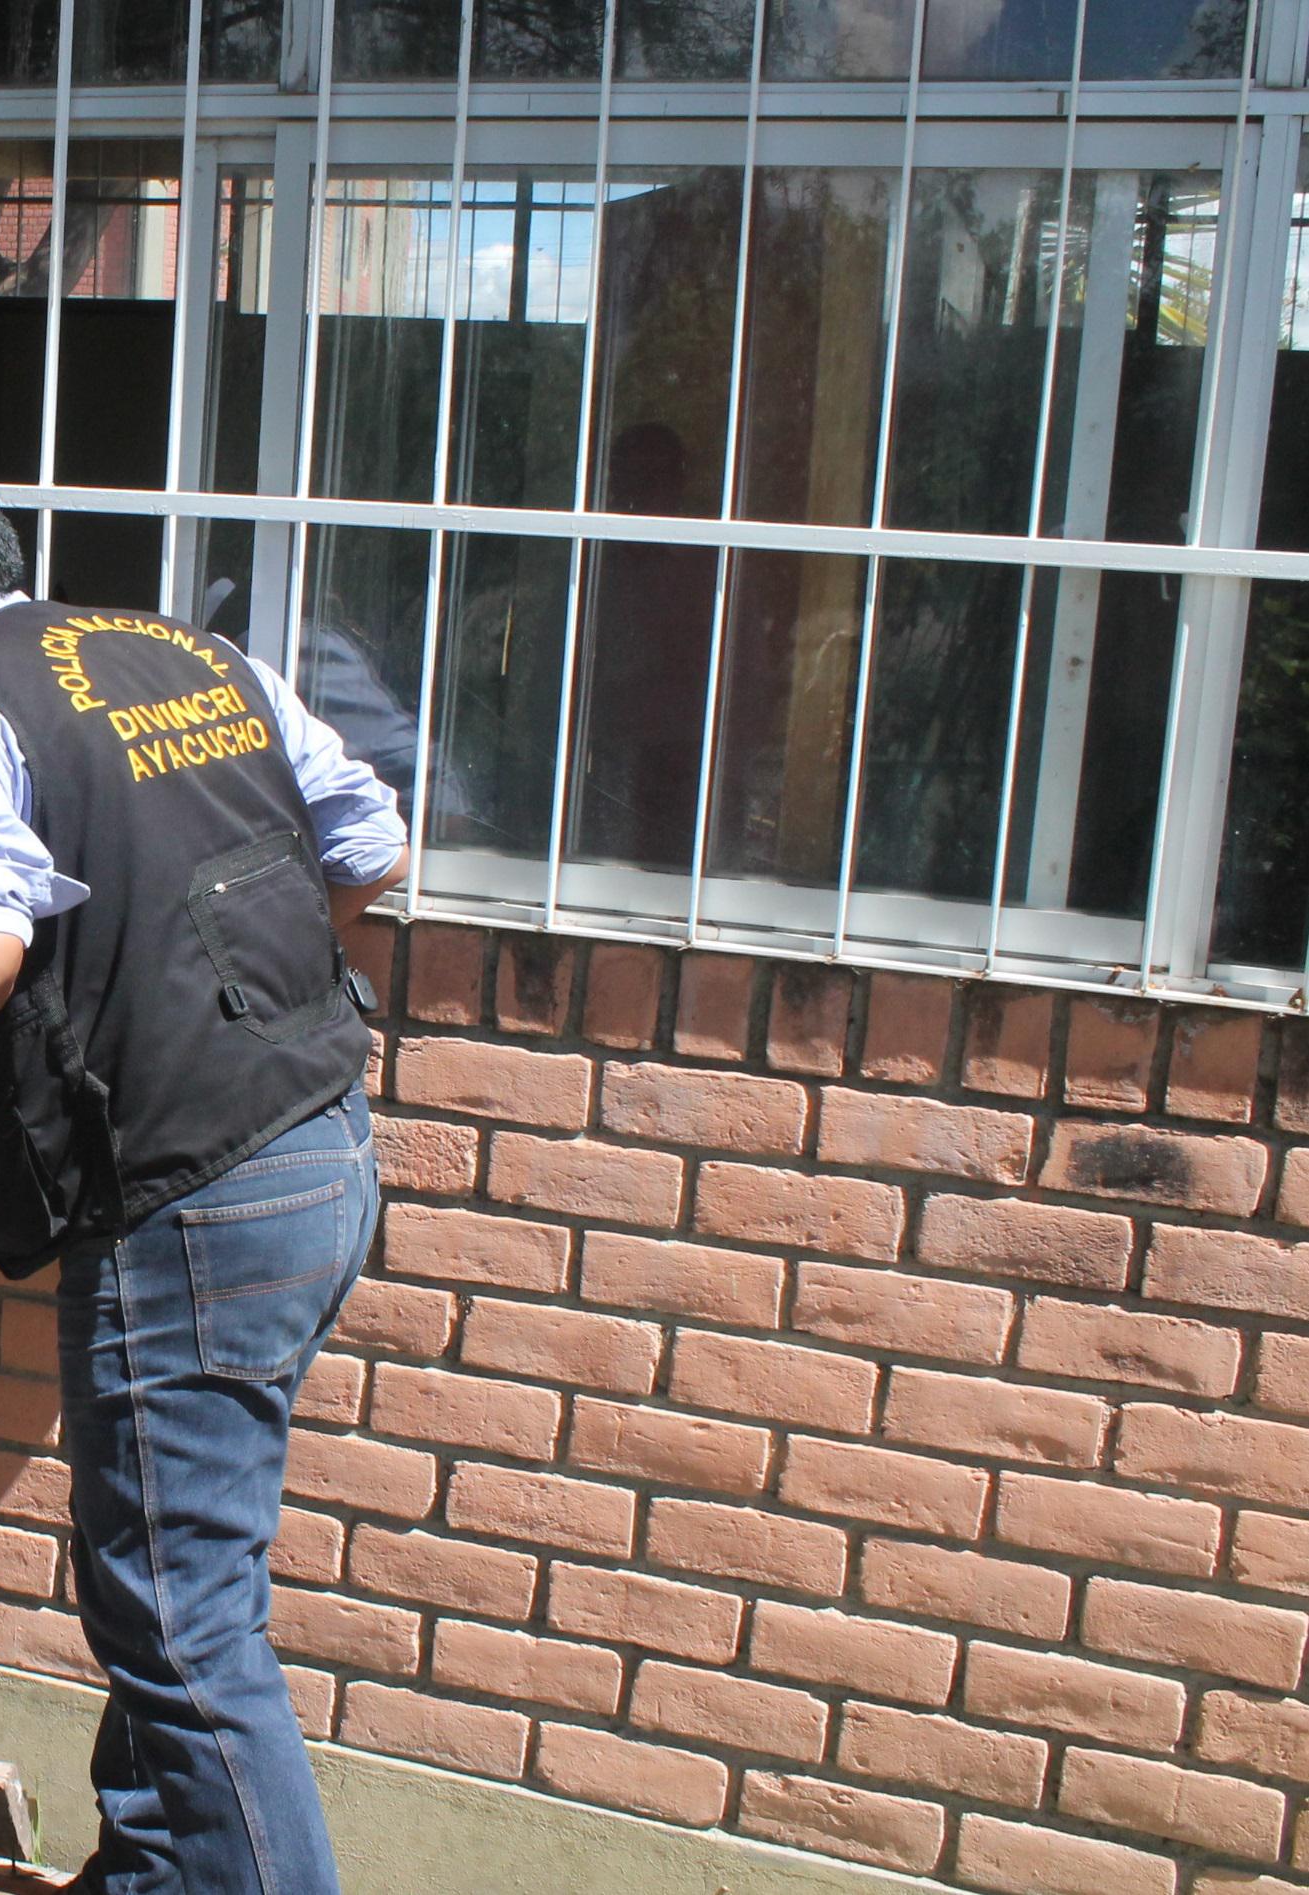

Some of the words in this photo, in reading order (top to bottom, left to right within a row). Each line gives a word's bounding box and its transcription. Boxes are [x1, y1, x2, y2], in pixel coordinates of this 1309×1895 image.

[40, 626, 107, 713] POLICIA
[66, 615, 229, 678] NACIONAL
[107, 683, 247, 741] DIVINCRI
[126, 717, 270, 782] AYACUCHO
